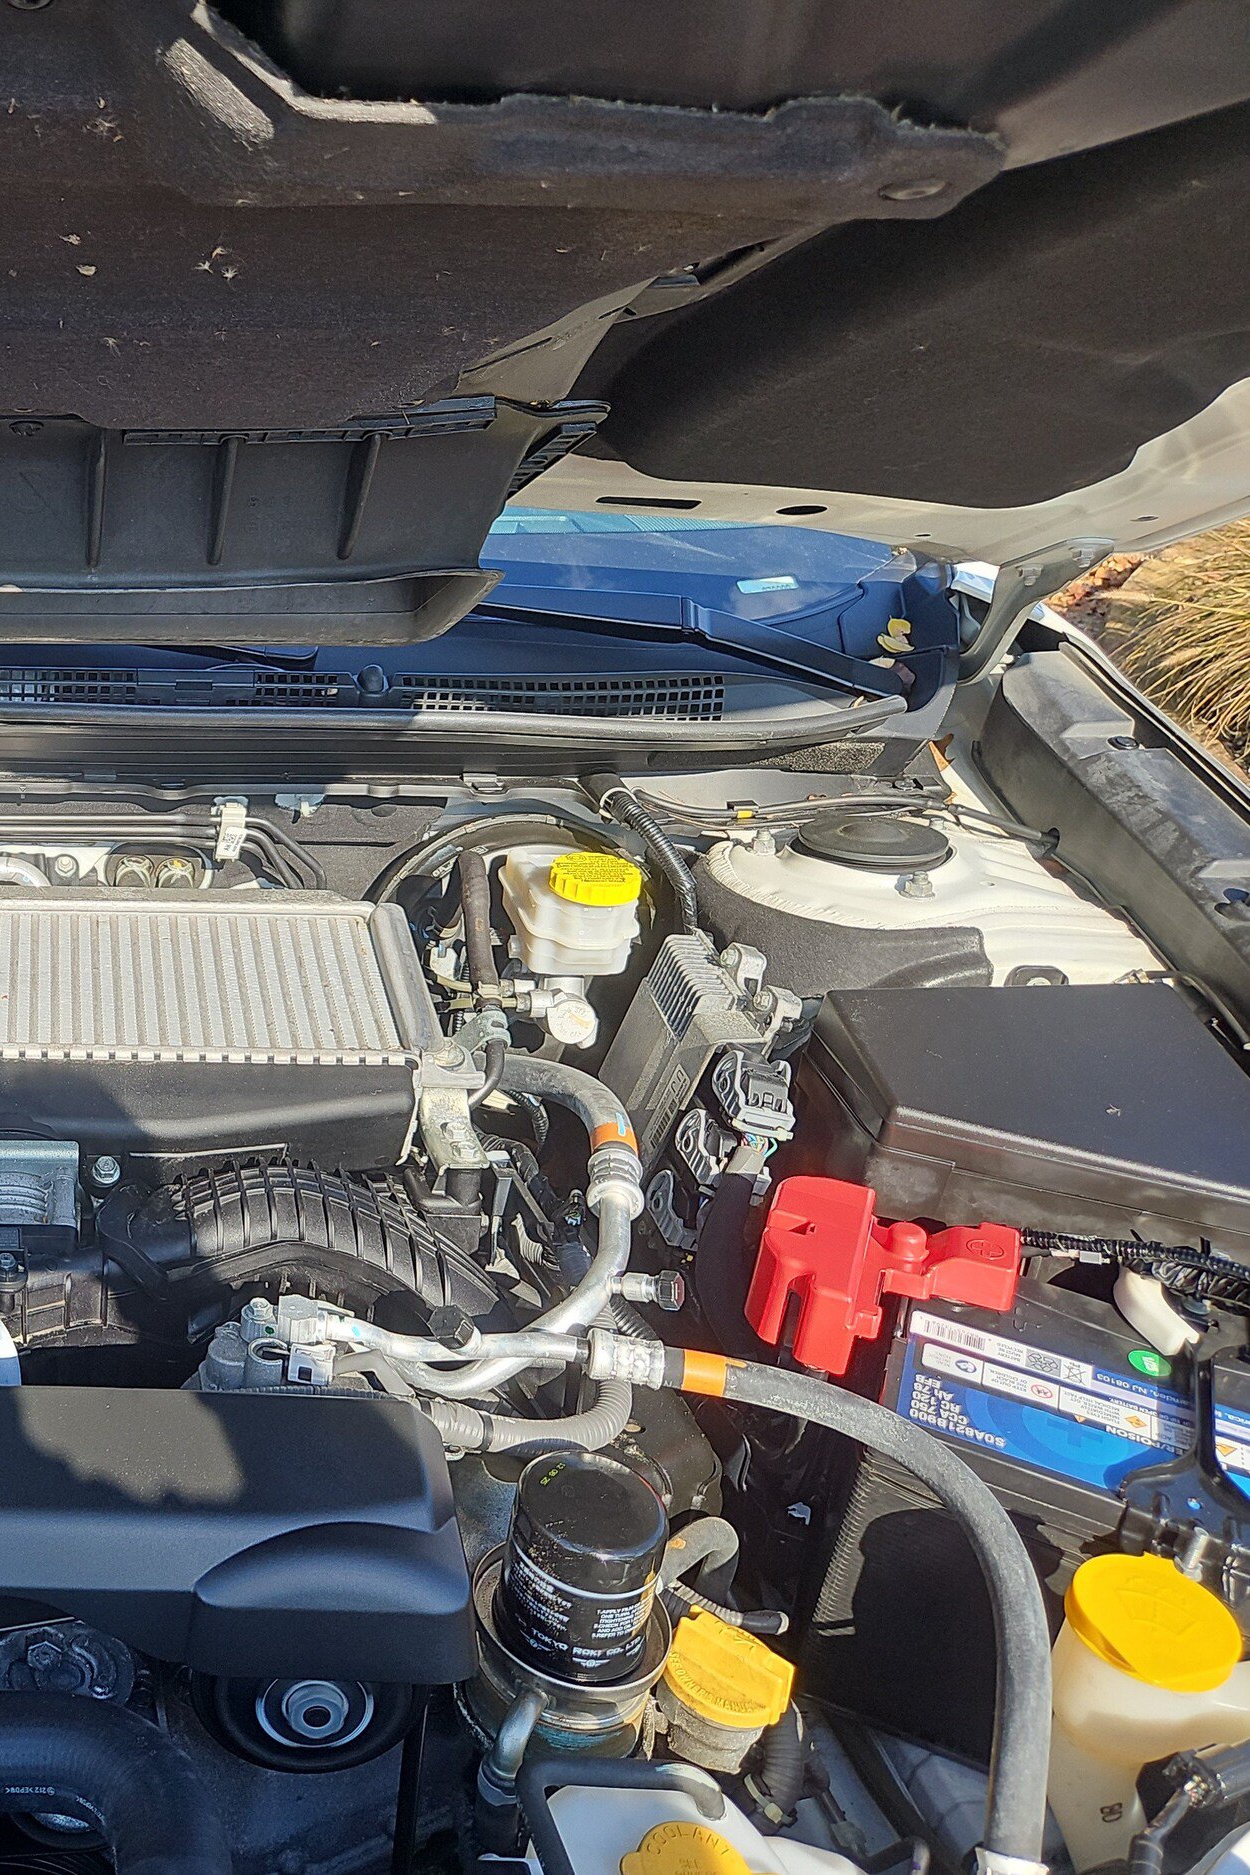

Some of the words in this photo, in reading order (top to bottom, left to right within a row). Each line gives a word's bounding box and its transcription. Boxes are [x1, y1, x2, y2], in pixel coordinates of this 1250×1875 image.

[998, 1351, 1021, 1362] BATTERY
[914, 1373, 942, 1389] EFB
[996, 1375, 1015, 1385] REACH
[1096, 1372, 1129, 1388] 08103
[1011, 1384, 1027, 1392] KEEP
[1132, 1384, 1148, 1394] NJ
[911, 1390, 938, 1406] 120
[933, 1388, 954, 1402] Ah
[910, 1399, 937, 1415] 750
[939, 1399, 962, 1414] RC
[1104, 1407, 1120, 1416] WITH
[1138, 1406, 1157, 1416] OPEN
[938, 1408, 970, 1425] CCA
[1101, 1415, 1120, 1424] FLUSH
[555, 1460, 566, 1471] 12
[547, 1467, 559, 1478] 08
[532, 1628, 568, 1651] TOKYO
[646, 1824, 730, 1856] COOLANT
